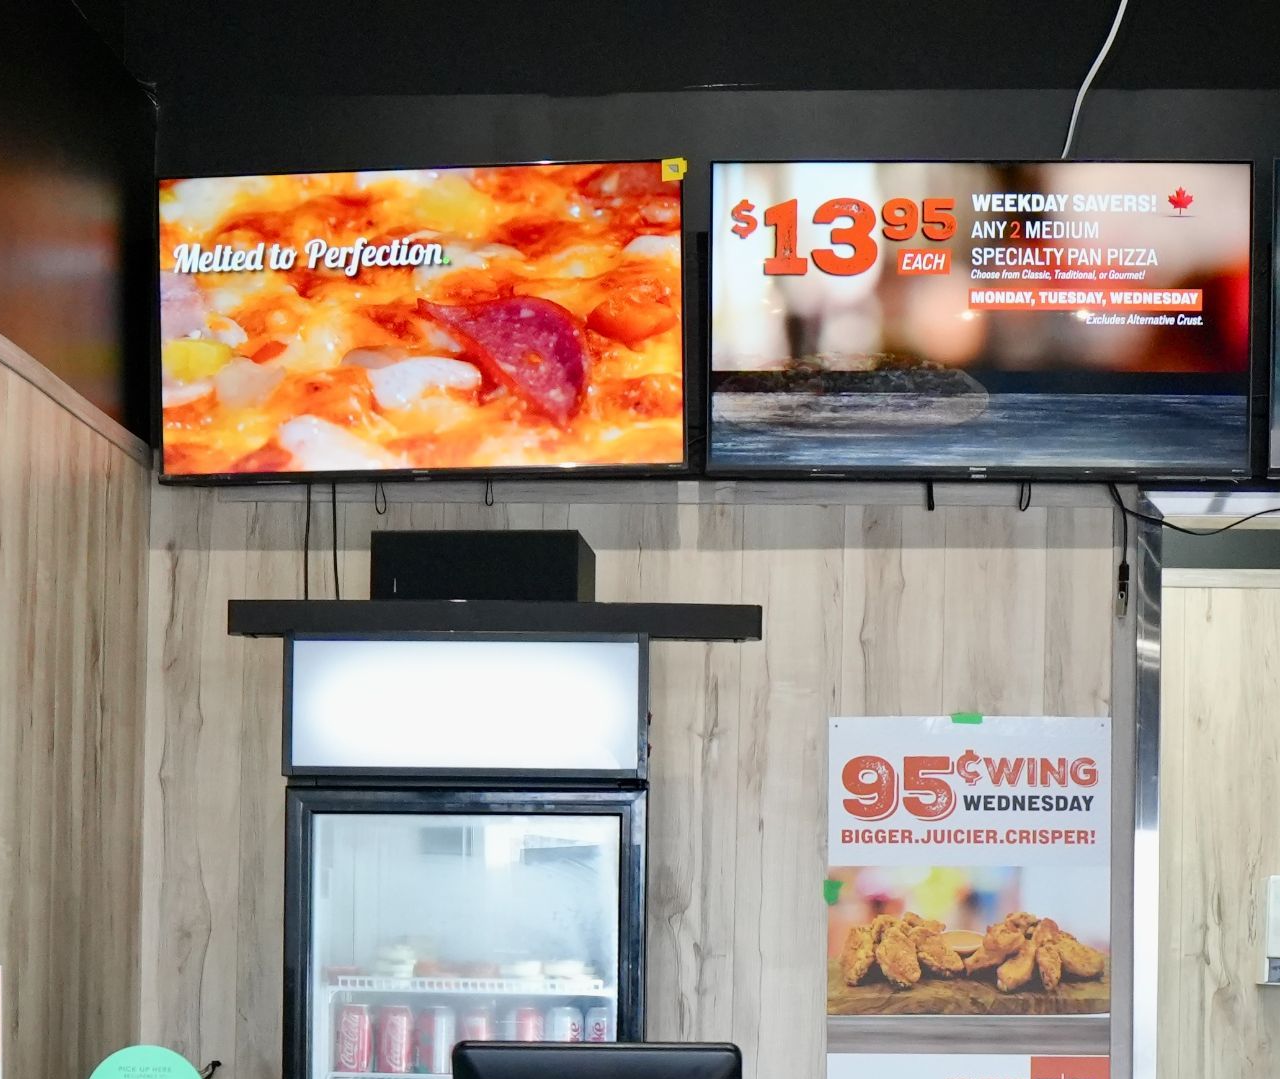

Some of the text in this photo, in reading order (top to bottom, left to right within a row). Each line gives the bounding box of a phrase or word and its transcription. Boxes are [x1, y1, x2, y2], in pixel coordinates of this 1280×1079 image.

[972, 194, 1157, 212] WEEKDAY SAVERS!
[971, 221, 1099, 239] ANY 2 MEDIUM
[173, 243, 263, 273] Melted
[270, 244, 296, 270] to
[901, 253, 945, 271] EACH
[971, 248, 1158, 266] SPECIALTY PAN PIZZA
[971, 269, 1145, 281] Choose from Classic, Traditional, or Gourmet!
[971, 291, 1198, 307] MONDAY, TUESDAY, WEDNESDAY
[1127, 314, 1175, 325] Alternative
[1177, 315, 1204, 325] Crust.
[983, 756, 1098, 788] WING
[963, 795, 1094, 811] WEDNESDAY
